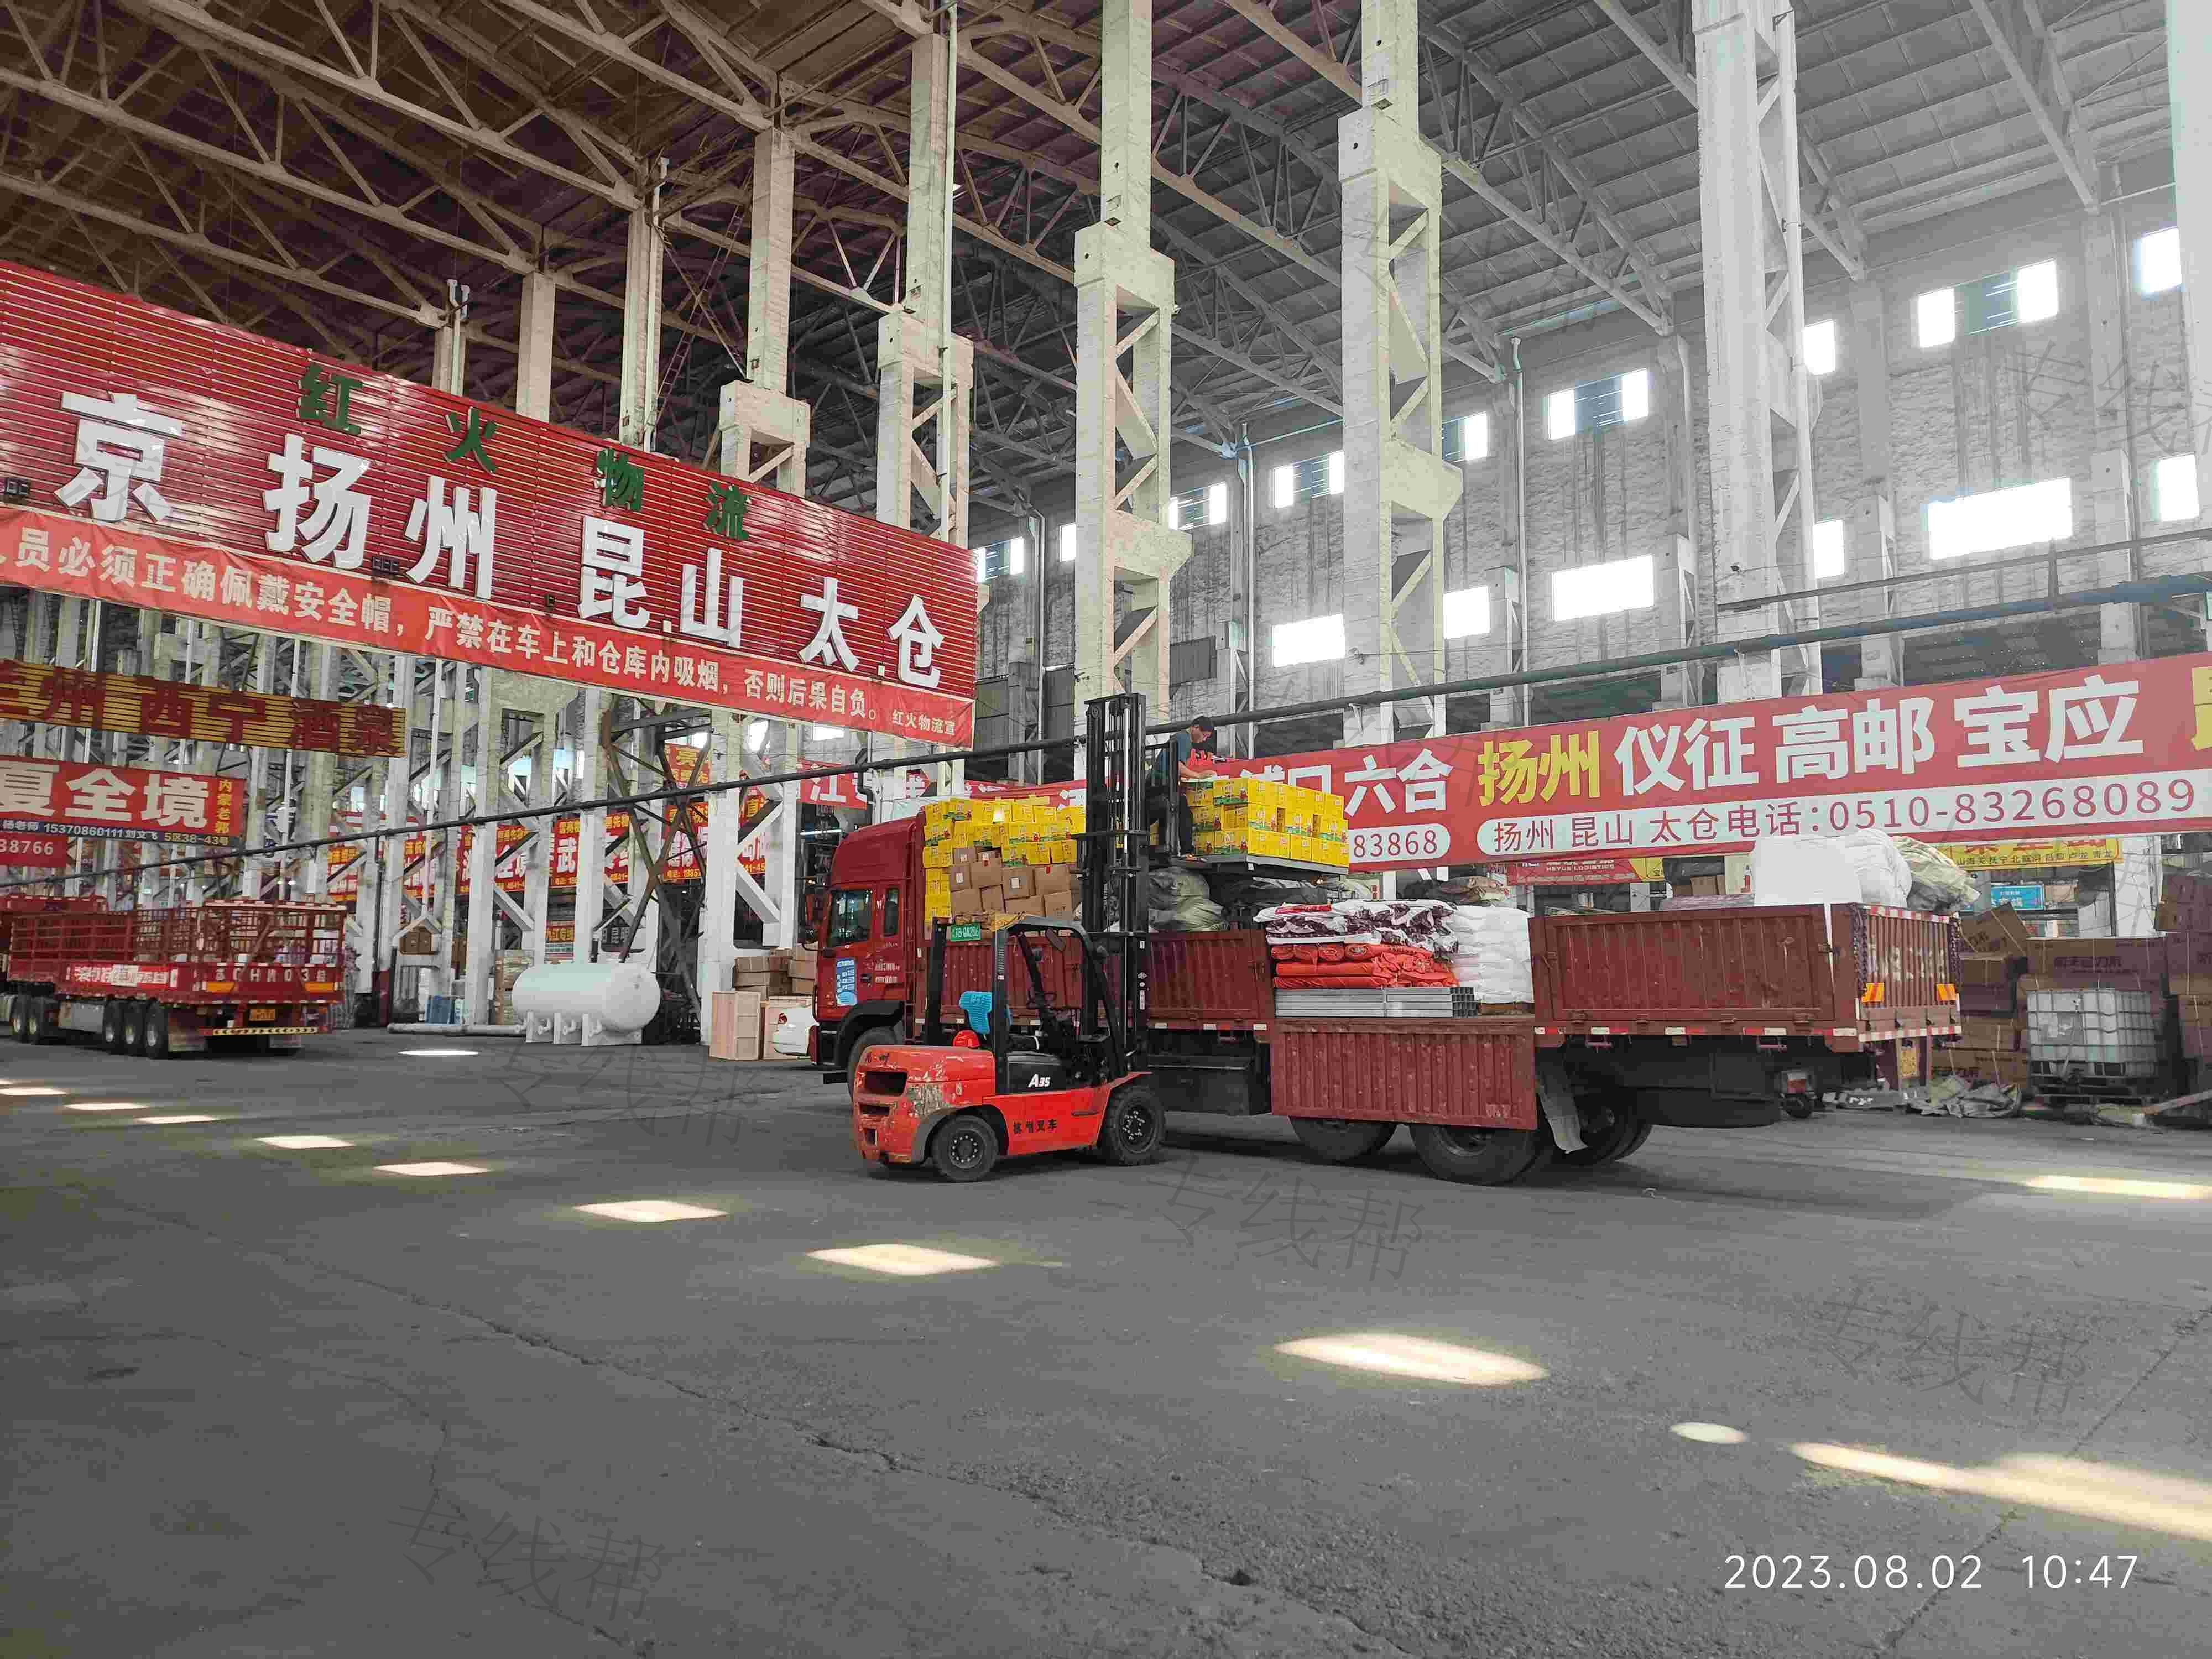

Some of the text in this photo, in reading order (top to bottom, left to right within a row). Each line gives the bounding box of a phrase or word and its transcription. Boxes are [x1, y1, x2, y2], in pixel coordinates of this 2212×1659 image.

[54, 392, 182, 521] 京
[262, 433, 496, 599] 扬州
[297, 362, 750, 540] 红火物流
[0, 526, 876, 721] 员必须正确佩戴安全帽，严禁在车上和仓库内吸烟，否则后果自负。
[1344, 749, 1453, 817] 六合
[1478, 729, 1601, 806] 扬州
[1614, 716, 1759, 796] 仪征
[1772, 697, 1935, 784] 高邮
[1954, 674, 2143, 769] 宝应
[1354, 830, 1437, 857] 83868
[1494, 822, 1553, 853] 扬州
[1571, 813, 1633, 848] 昆山
[1027, 1073, 1051, 1088] A35
